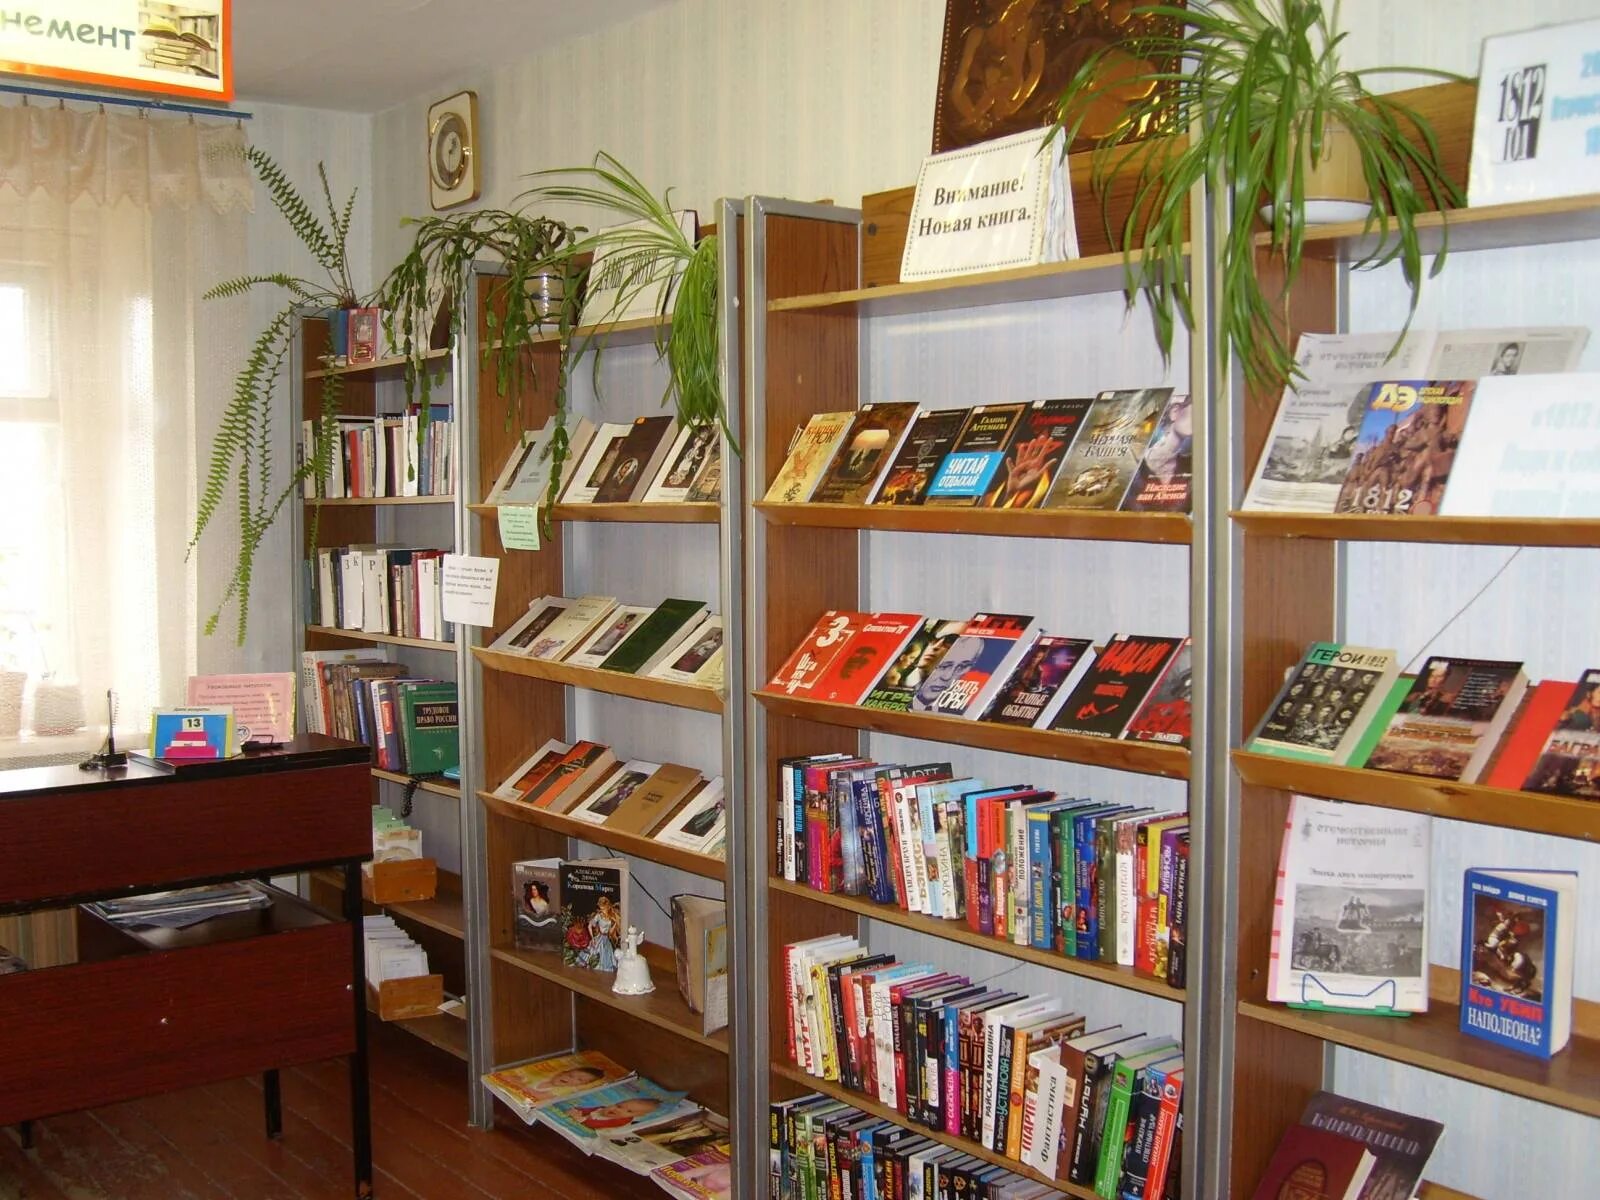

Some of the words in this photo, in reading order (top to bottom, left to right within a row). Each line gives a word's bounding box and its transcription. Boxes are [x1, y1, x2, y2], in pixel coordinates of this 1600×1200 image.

[914, 173, 1026, 206] Внимание!
[899, 215, 972, 237] Новая
[977, 207, 1031, 229] книга.
[944, 455, 990, 474] ЧИТАЙ
[1352, 483, 1414, 510] 1812
[1312, 648, 1364, 664] ГЕРОИ
[938, 691, 973, 710] ГОРБИ
[949, 680, 980, 694] УБИТЬ
[187, 718, 201, 728] 13
[1467, 1007, 1542, 1046] НАПОЛЕОНА?
[986, 1025, 994, 1070] МАШИНА
[985, 1072, 993, 1118] РАЙСКАЯ
[1040, 1075, 1057, 1162] Фантастика
